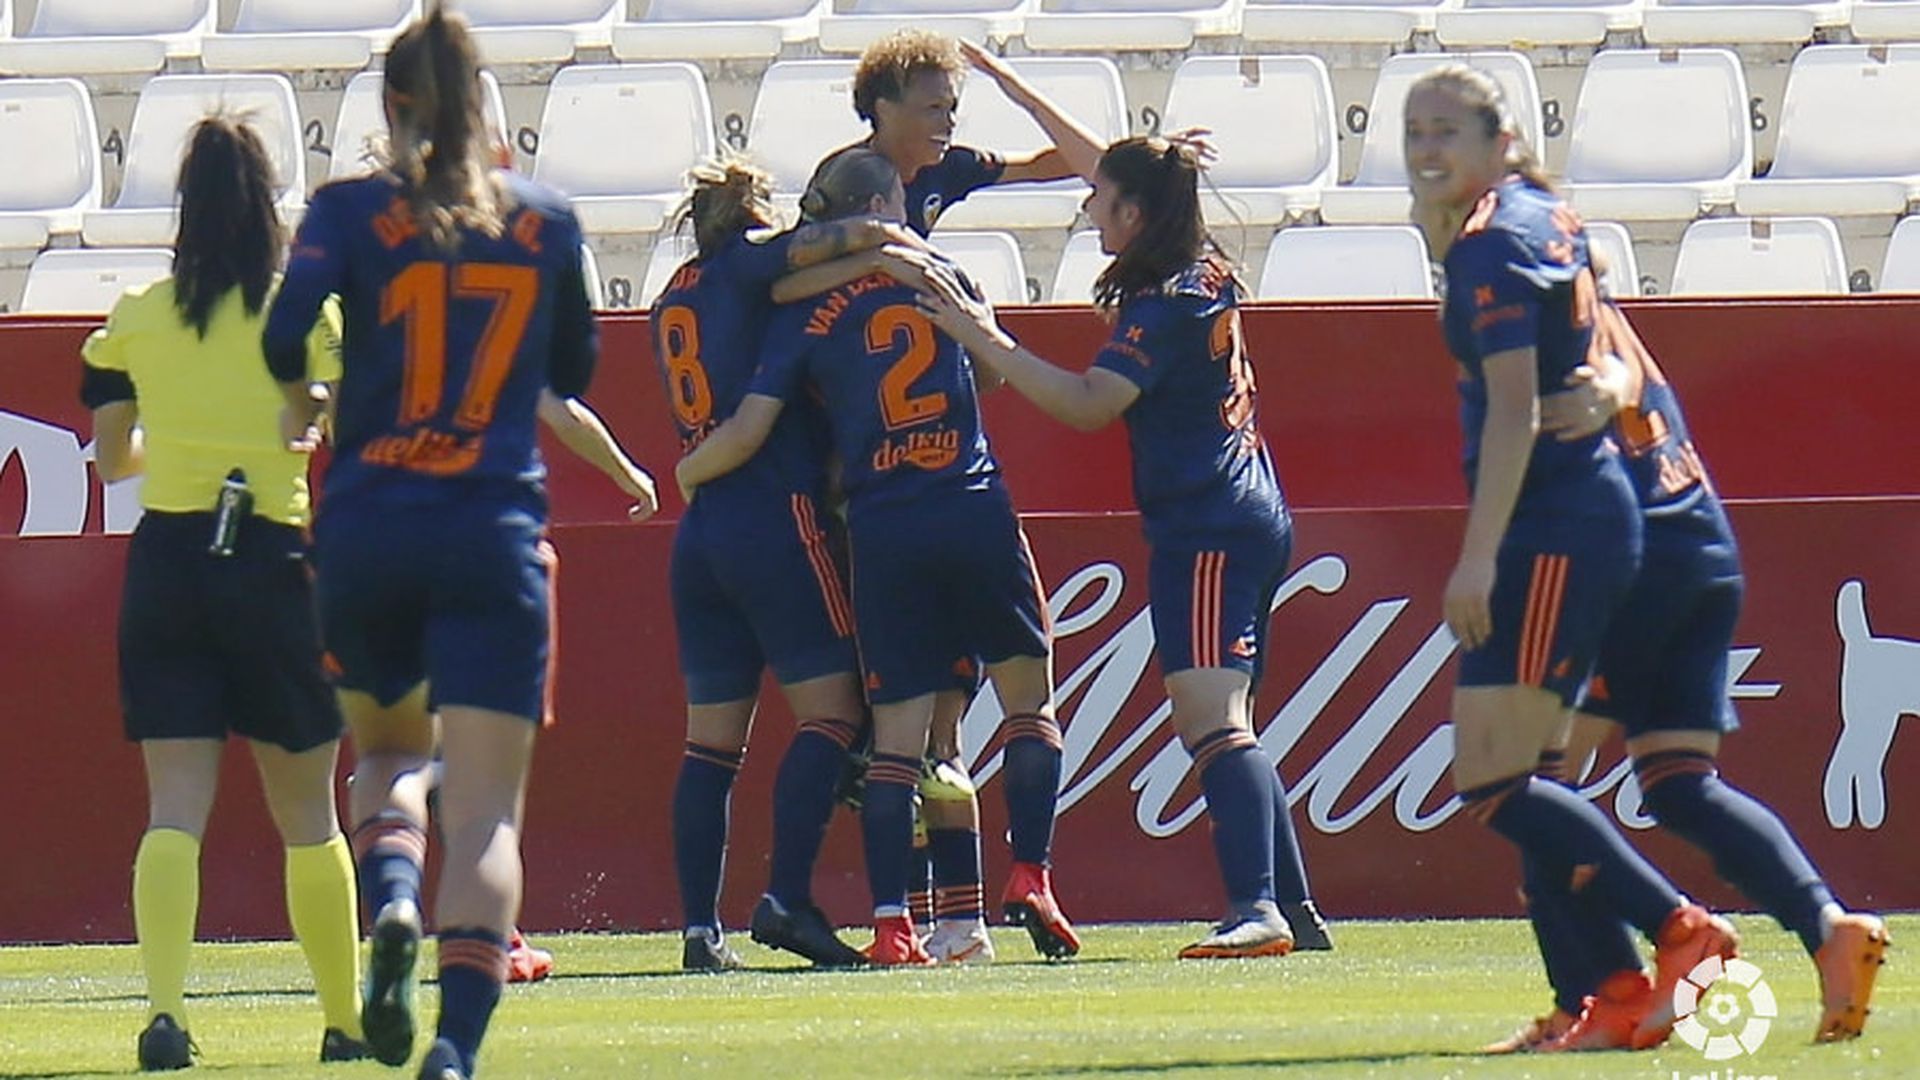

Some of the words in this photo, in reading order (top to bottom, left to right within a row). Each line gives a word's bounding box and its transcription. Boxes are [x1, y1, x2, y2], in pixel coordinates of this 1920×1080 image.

[1543, 99, 1565, 137] 8
[1750, 97, 1768, 131] 6
[304, 119, 331, 156] 2
[803, 291, 849, 335] VAN
[378, 260, 541, 433] 17
[658, 305, 714, 430] 8
[864, 304, 949, 432] 2
